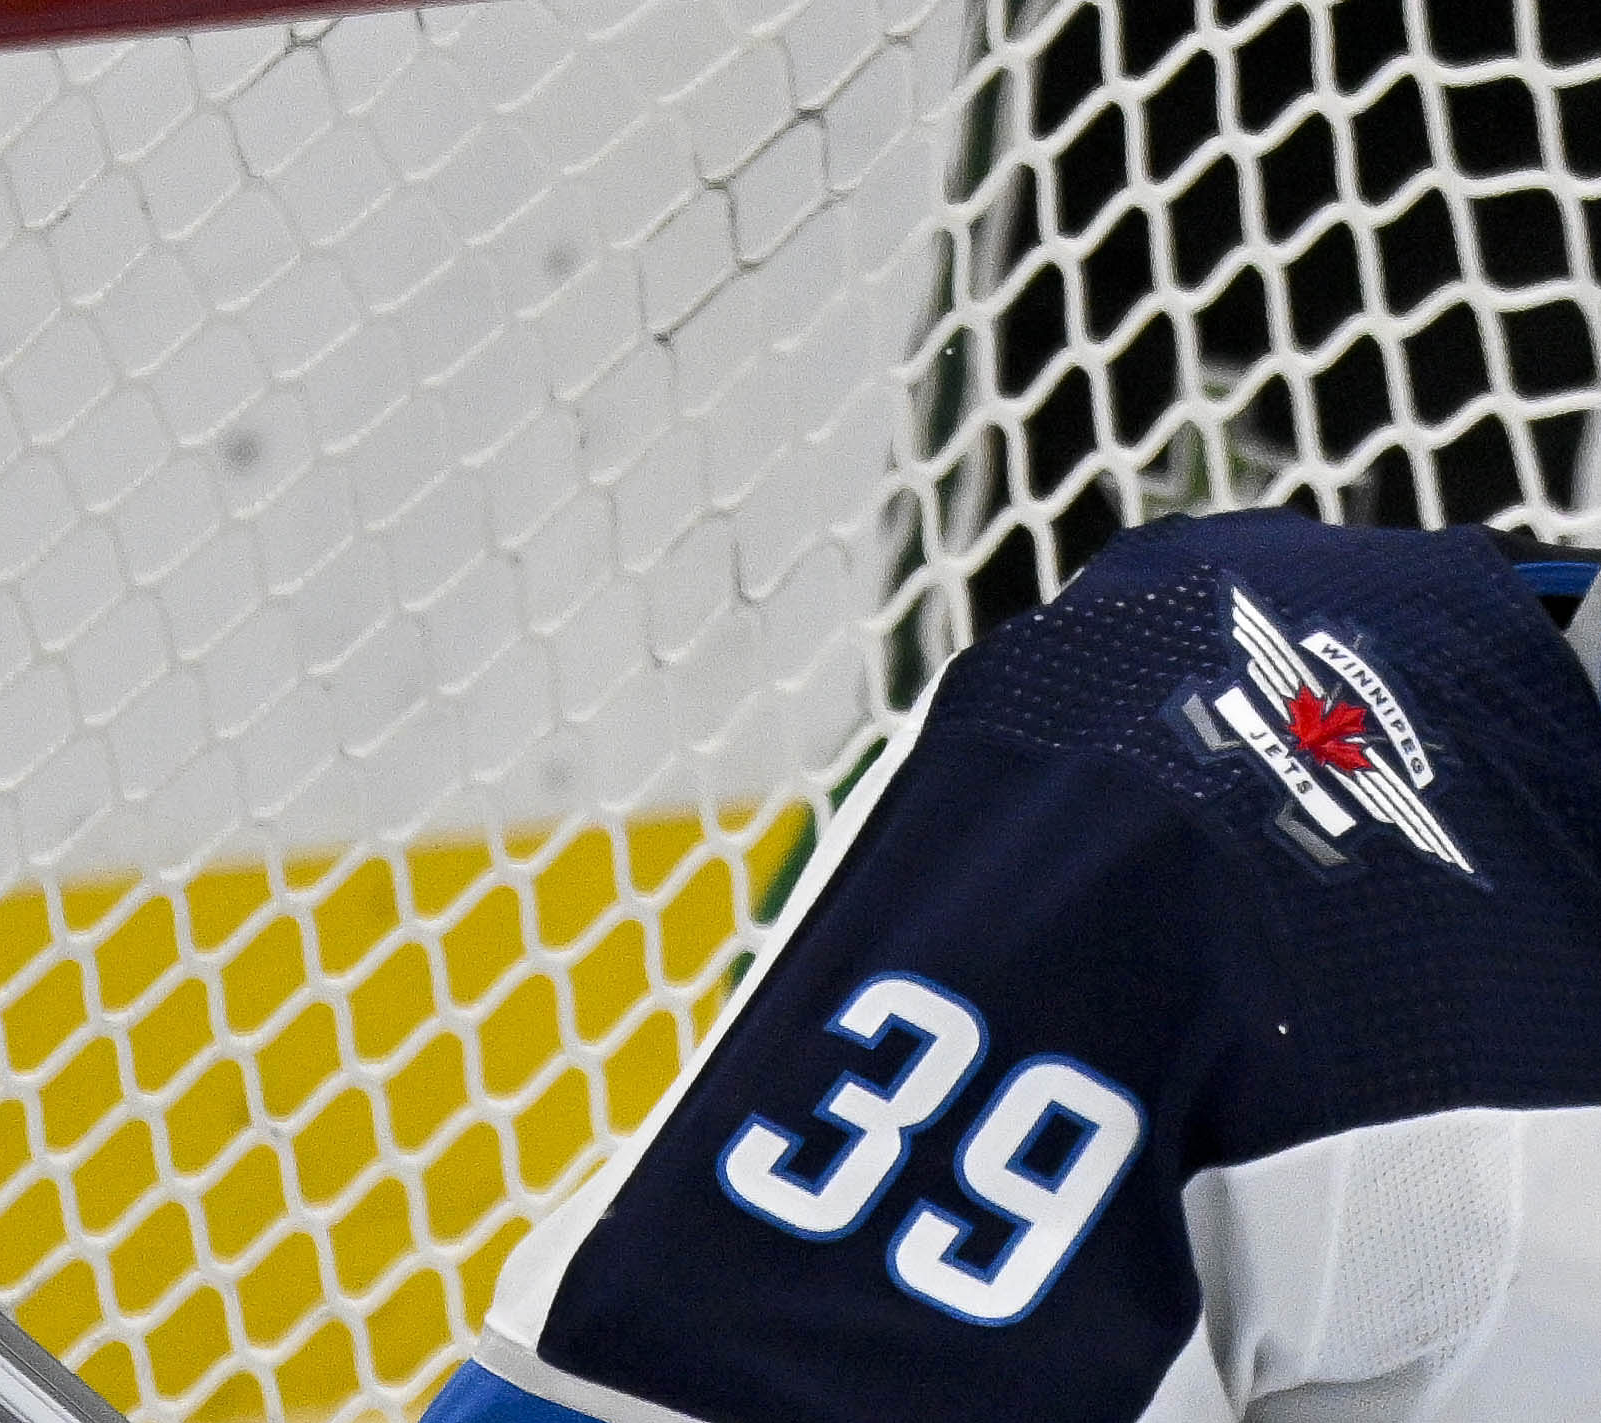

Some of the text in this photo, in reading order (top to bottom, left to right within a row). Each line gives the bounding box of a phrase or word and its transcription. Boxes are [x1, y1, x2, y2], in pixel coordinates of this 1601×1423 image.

[1249, 730, 1315, 796] JETS
[1320, 642, 1426, 776] WINNIPEG
[715, 970, 1150, 1328] 39
